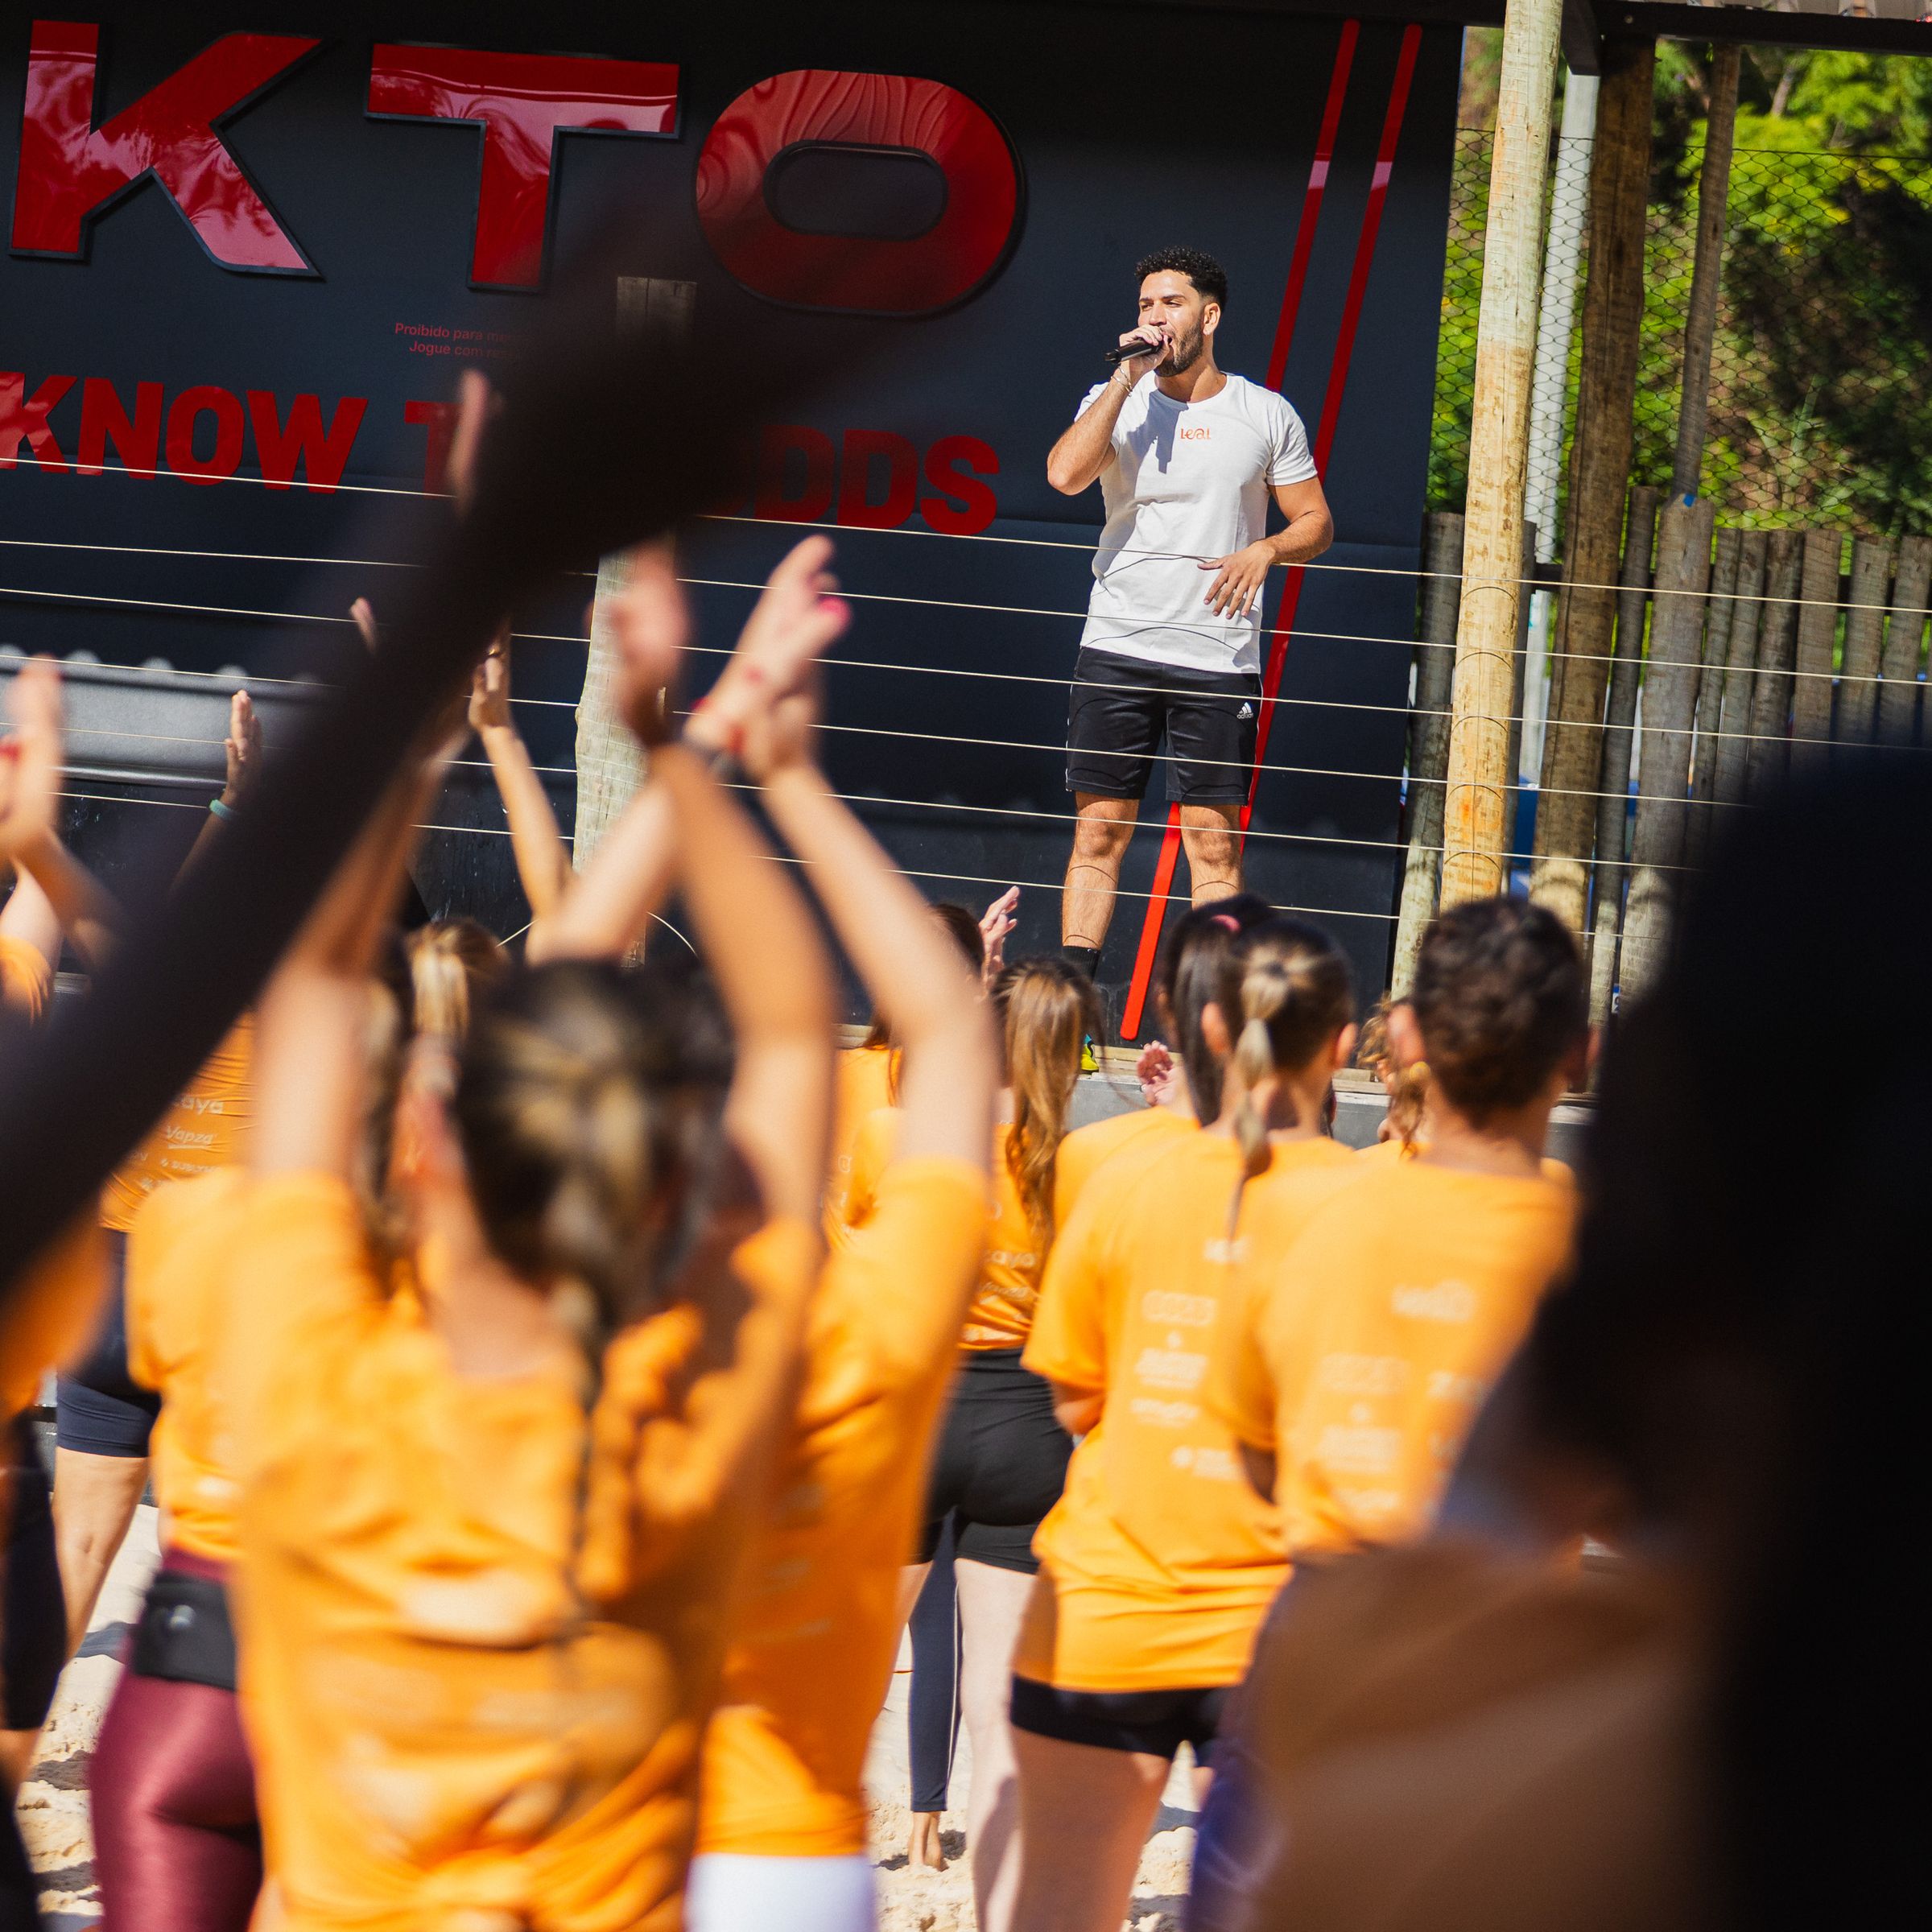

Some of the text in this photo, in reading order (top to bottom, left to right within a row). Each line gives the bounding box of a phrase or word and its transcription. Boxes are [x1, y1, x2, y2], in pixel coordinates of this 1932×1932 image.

[11, 19, 1018, 311] KTO
[394, 322, 450, 338] Proibido
[453, 328, 483, 341] para
[409, 341, 451, 356] Jogue
[0, 370, 368, 493] KNOW
[173, 1096, 224, 1115] aya
